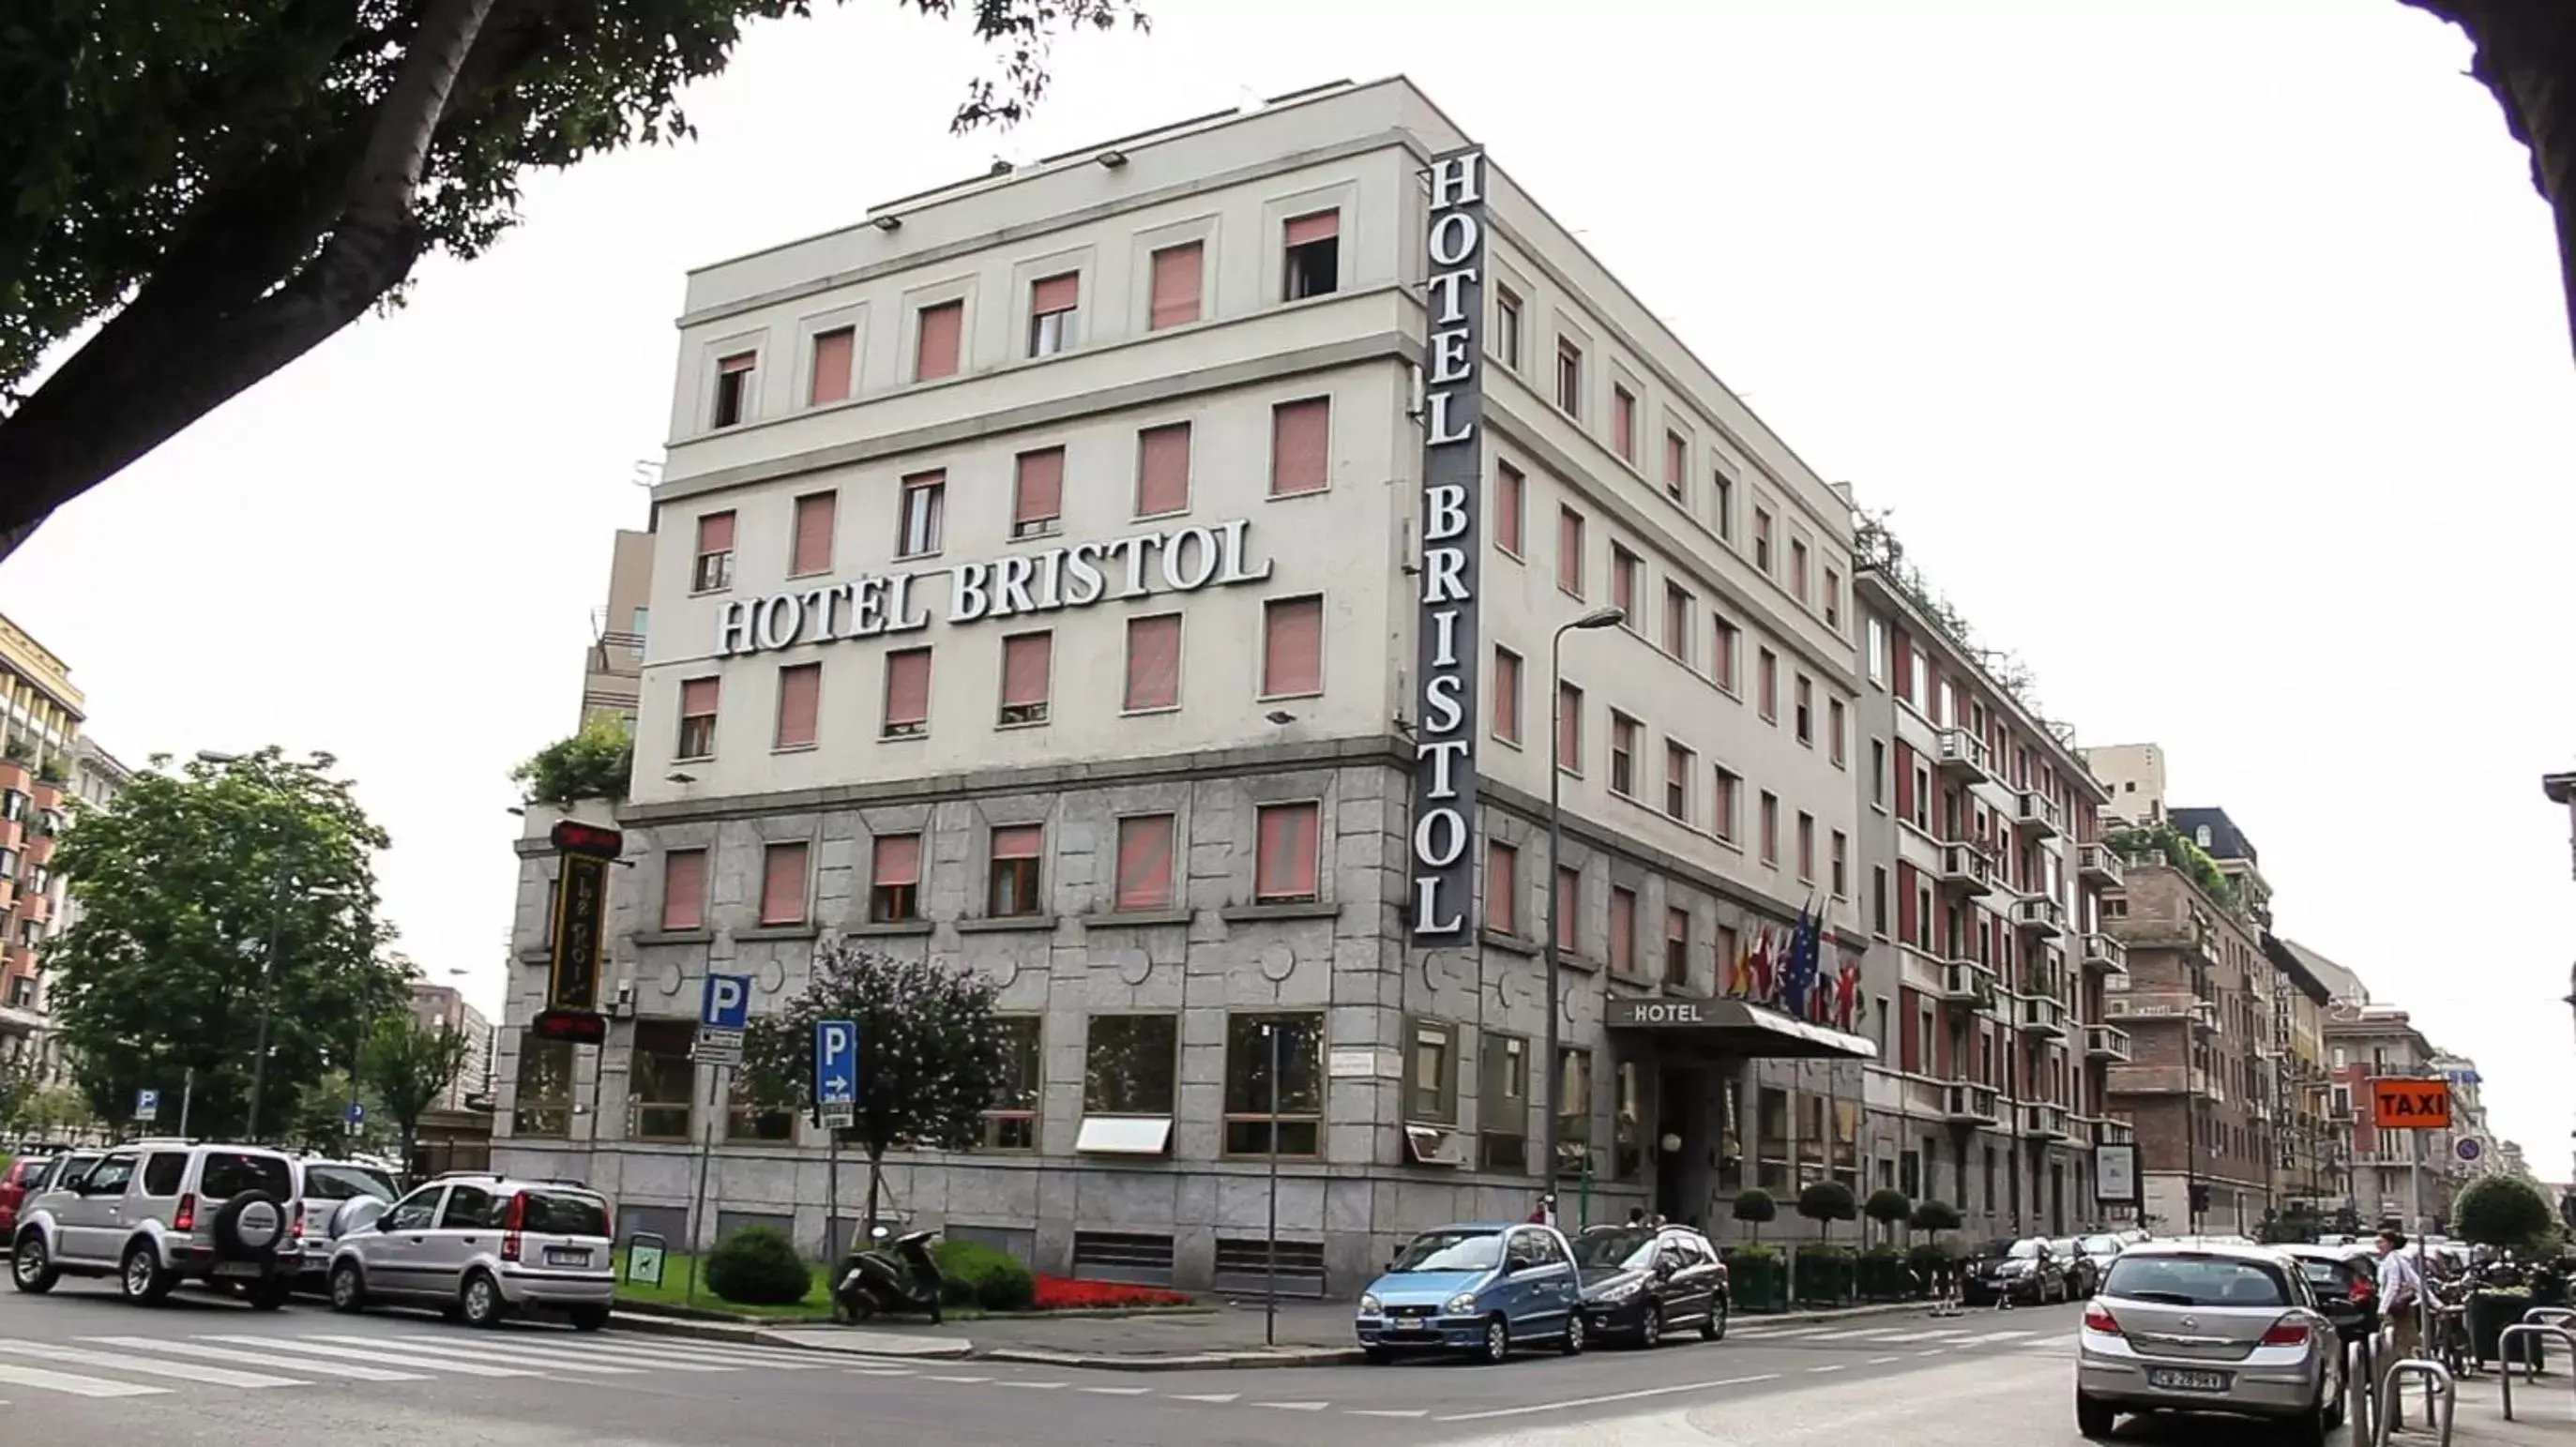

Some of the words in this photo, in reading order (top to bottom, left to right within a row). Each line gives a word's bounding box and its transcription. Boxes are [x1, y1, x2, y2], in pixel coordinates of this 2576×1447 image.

[1426, 150, 1482, 447] HOTEL
[716, 573, 930, 657] HOTEL
[947, 519, 1274, 625] BRISTOL
[1415, 484, 1470, 936] BRISTOL
[709, 978, 743, 1023] P
[1635, 1004, 1704, 1022] HOTEL
[825, 1027, 847, 1066] P
[141, 1091, 156, 1107] P
[2379, 1093, 2445, 1116] TAXI
